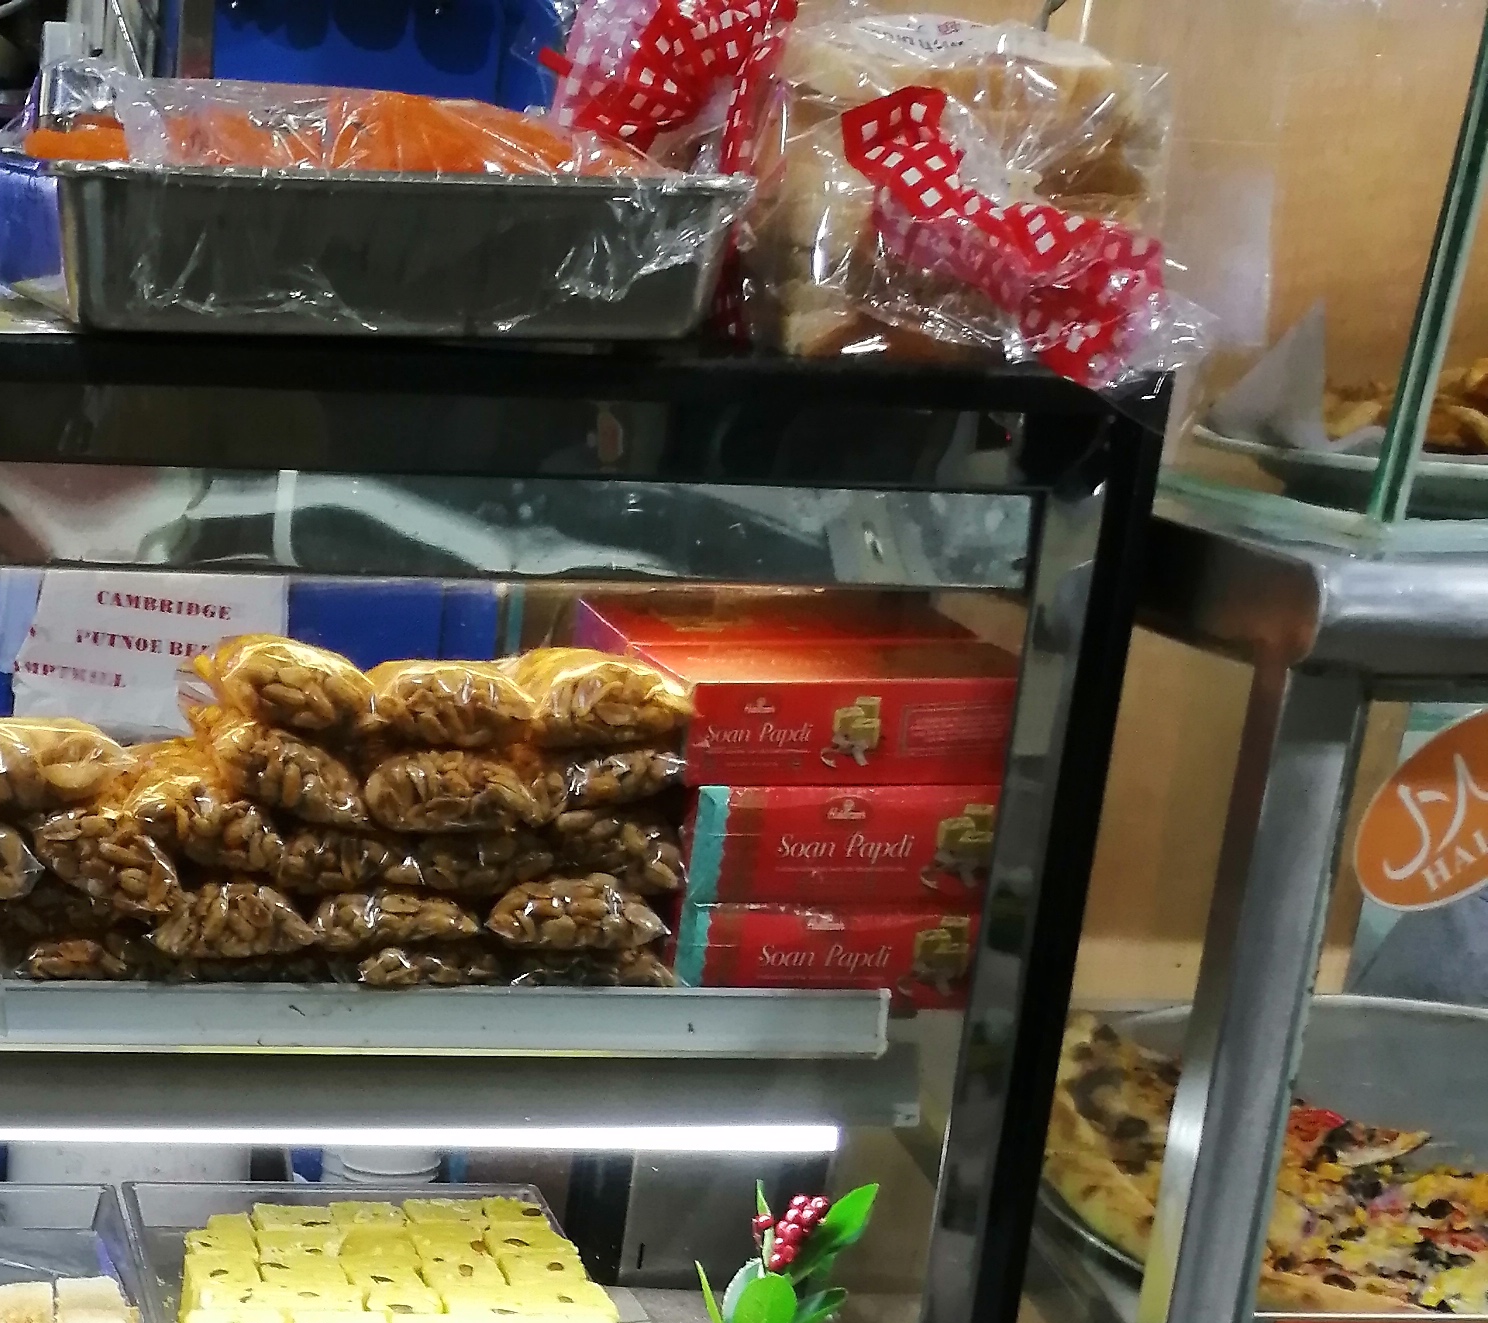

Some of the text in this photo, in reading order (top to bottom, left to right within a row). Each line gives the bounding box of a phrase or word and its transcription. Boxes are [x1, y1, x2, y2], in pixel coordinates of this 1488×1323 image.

[97, 591, 232, 621] CAMBRIDGE
[706, 722, 814, 748] Soan Papdi
[778, 831, 915, 864] Soan Papdi
[758, 943, 893, 974] Soan Papdi
